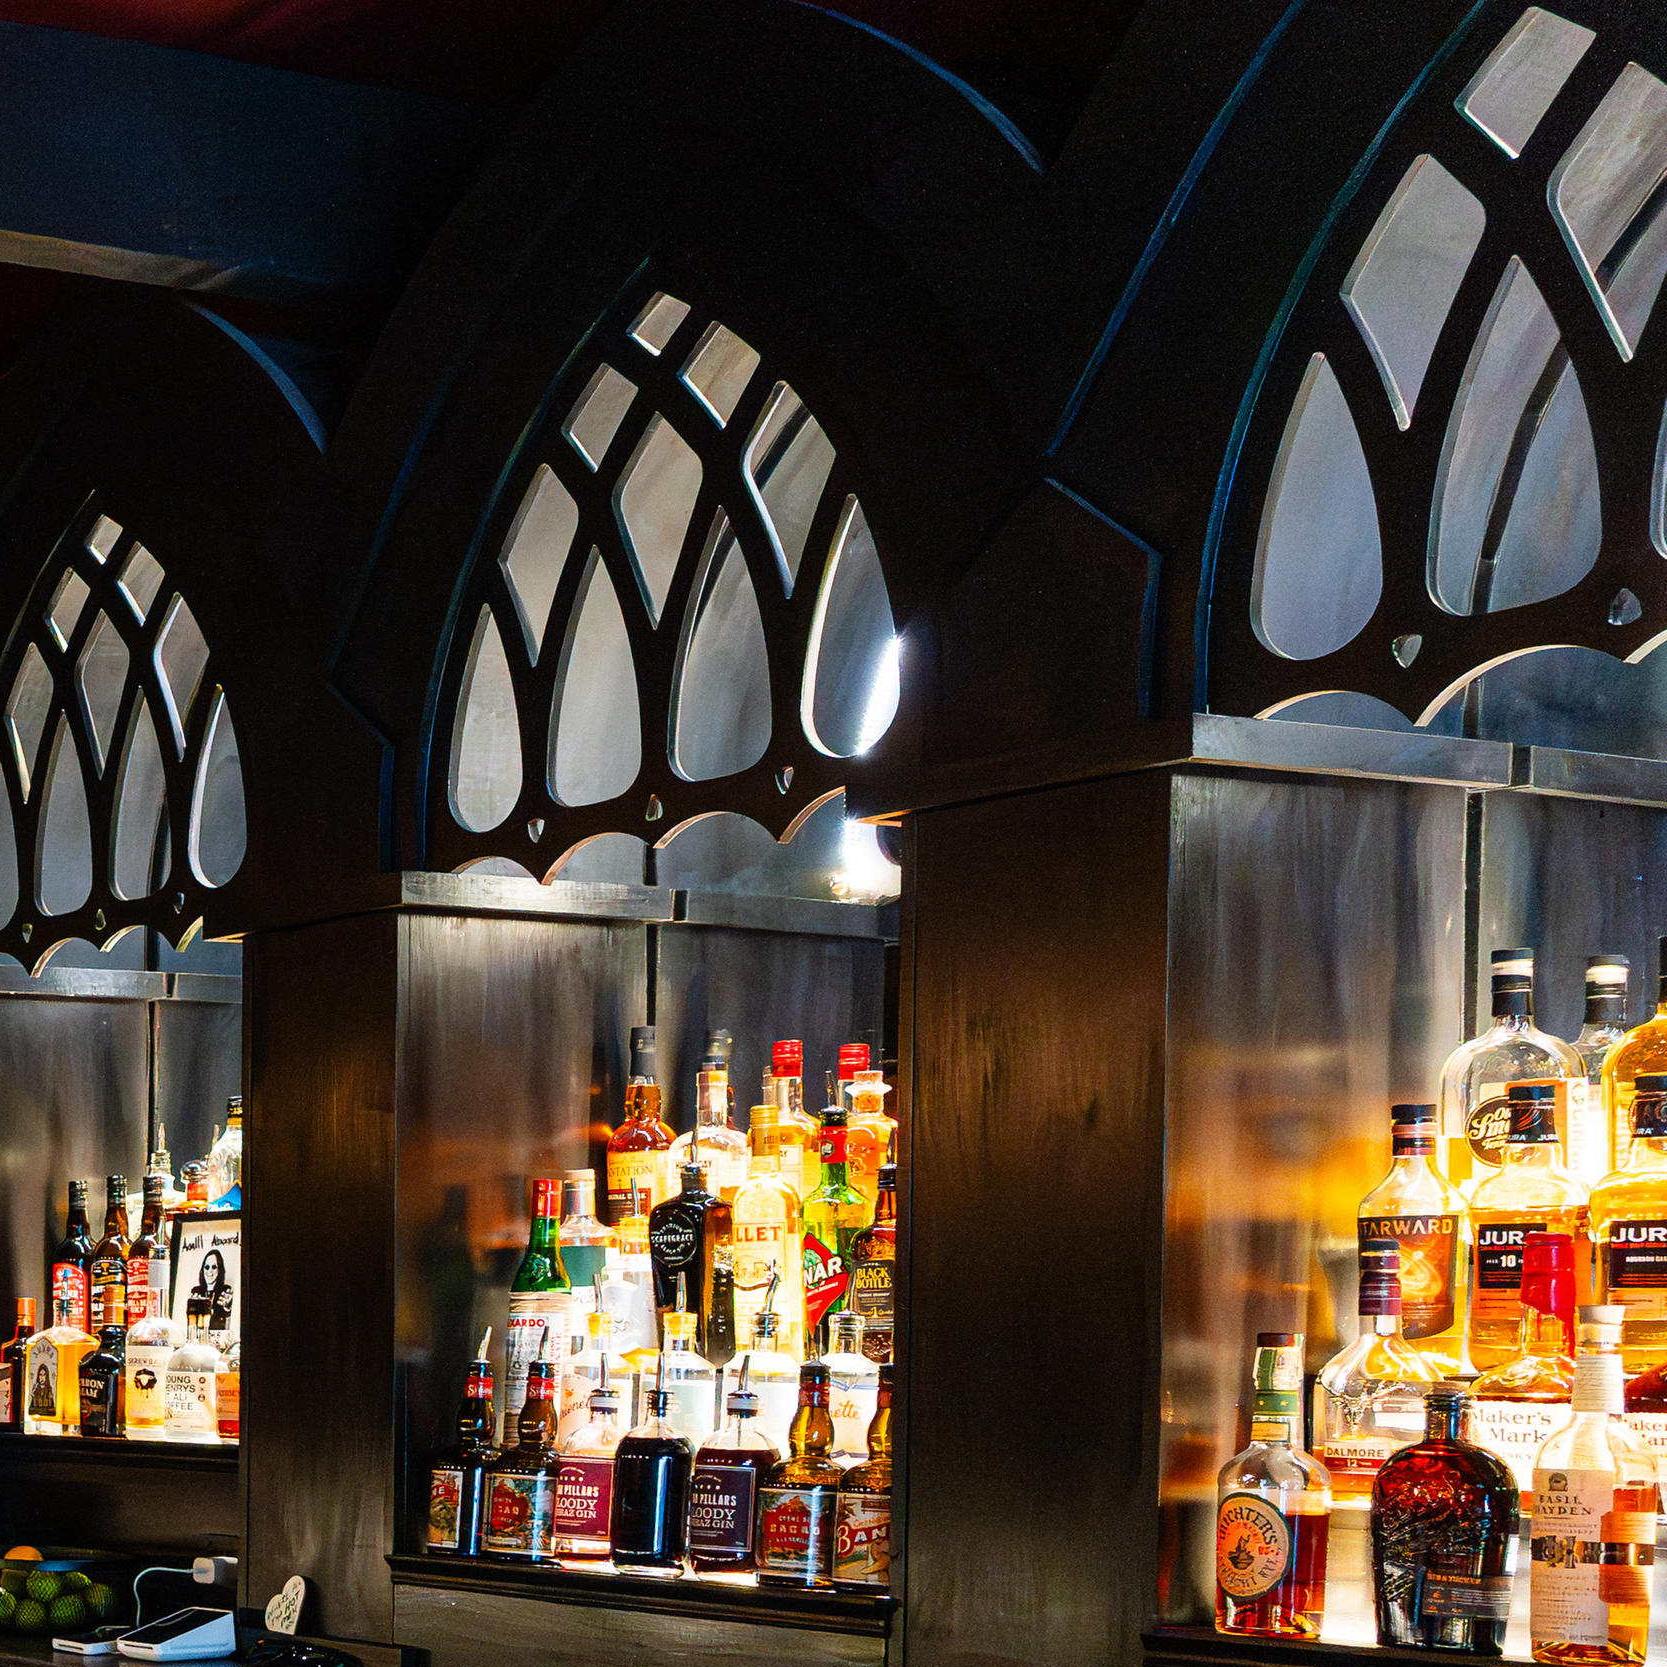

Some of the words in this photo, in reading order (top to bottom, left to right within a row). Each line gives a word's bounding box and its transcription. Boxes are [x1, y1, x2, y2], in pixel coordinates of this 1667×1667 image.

[1500, 1254, 1516, 1267] 10
[856, 1267, 889, 1279] BLACK
[856, 1278, 892, 1289] BOTTLE
[1489, 1428, 1548, 1444] Mark
[1326, 1447, 1385, 1458] DALMORE
[1347, 1459, 1358, 1467] 12
[564, 1485, 600, 1498] PILLARS
[699, 1494, 737, 1506] PILLARS
[1539, 1494, 1583, 1505] BASIL
[578, 1510, 597, 1519] GIN
[712, 1519, 735, 1529] GIN
